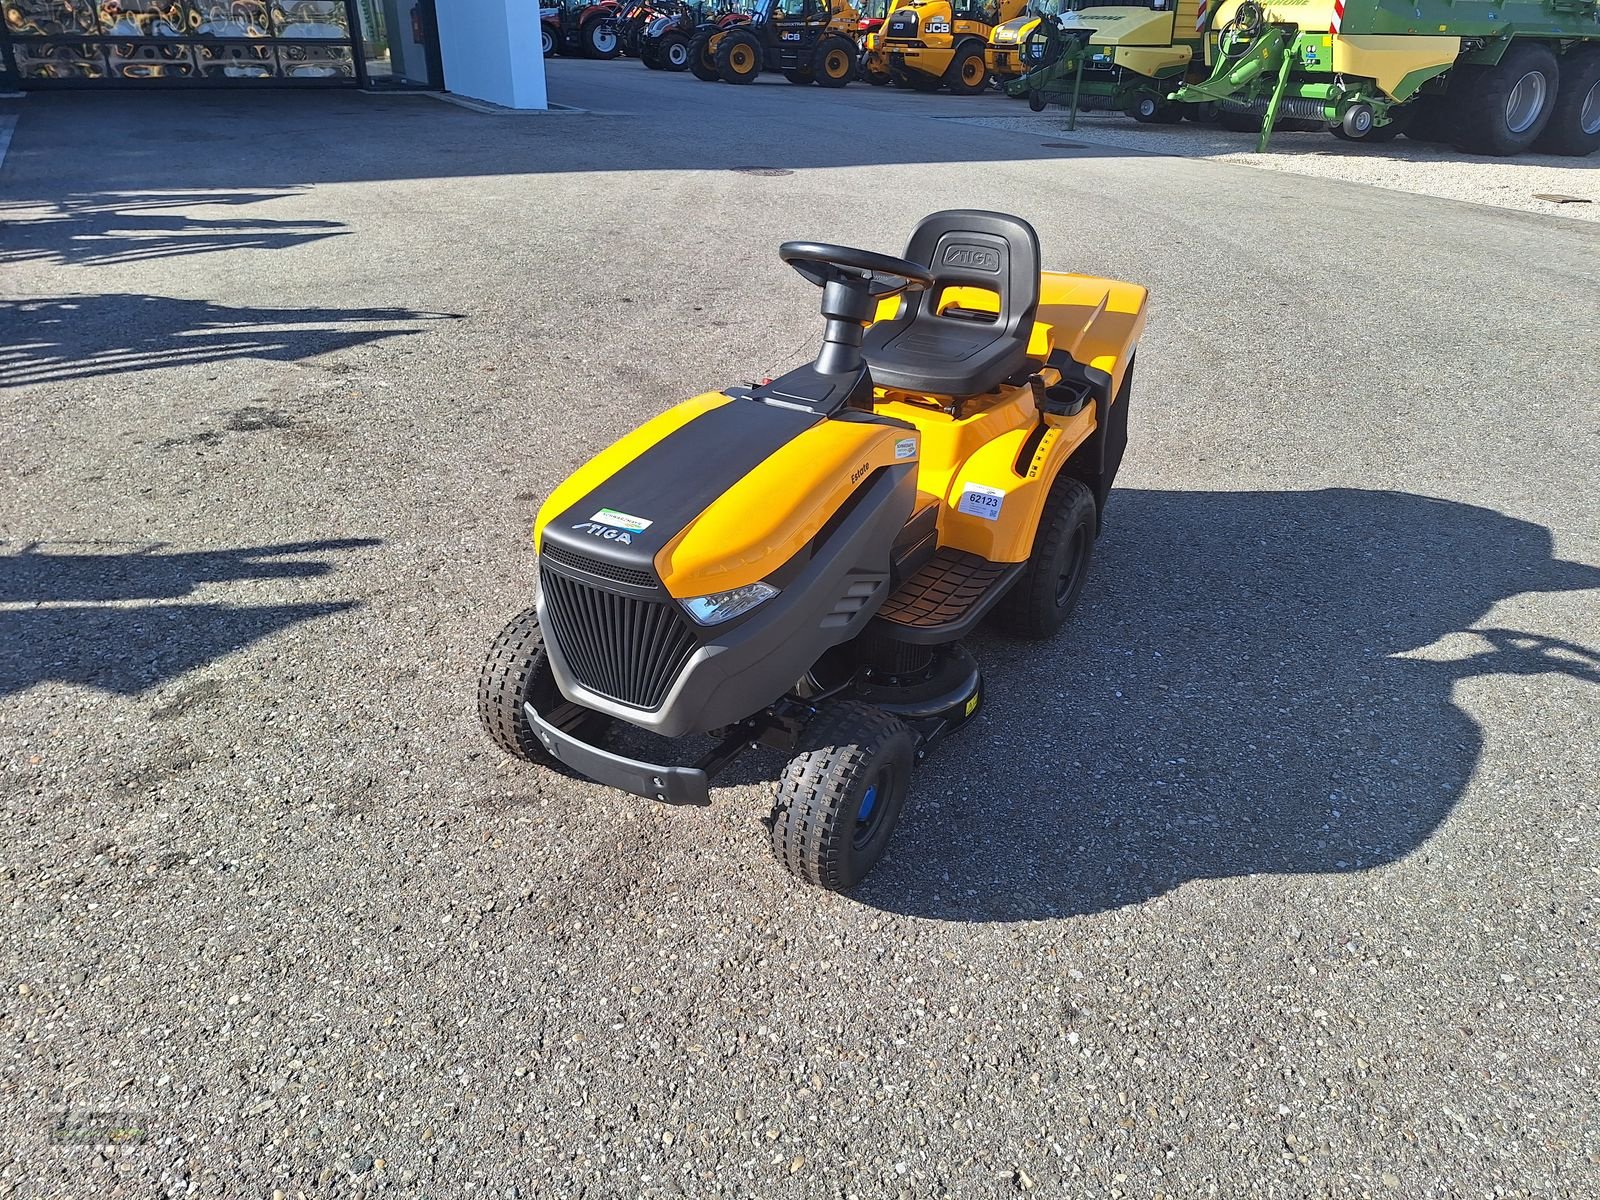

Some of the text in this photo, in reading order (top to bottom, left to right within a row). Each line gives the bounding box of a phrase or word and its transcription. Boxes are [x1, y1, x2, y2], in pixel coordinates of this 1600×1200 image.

[925, 23, 950, 33] JCB
[782, 33, 800, 41] JCB
[947, 249, 998, 268] STIGA
[850, 462, 870, 485] Estate
[969, 493, 998, 508] 62123
[571, 522, 632, 545] STIGA
